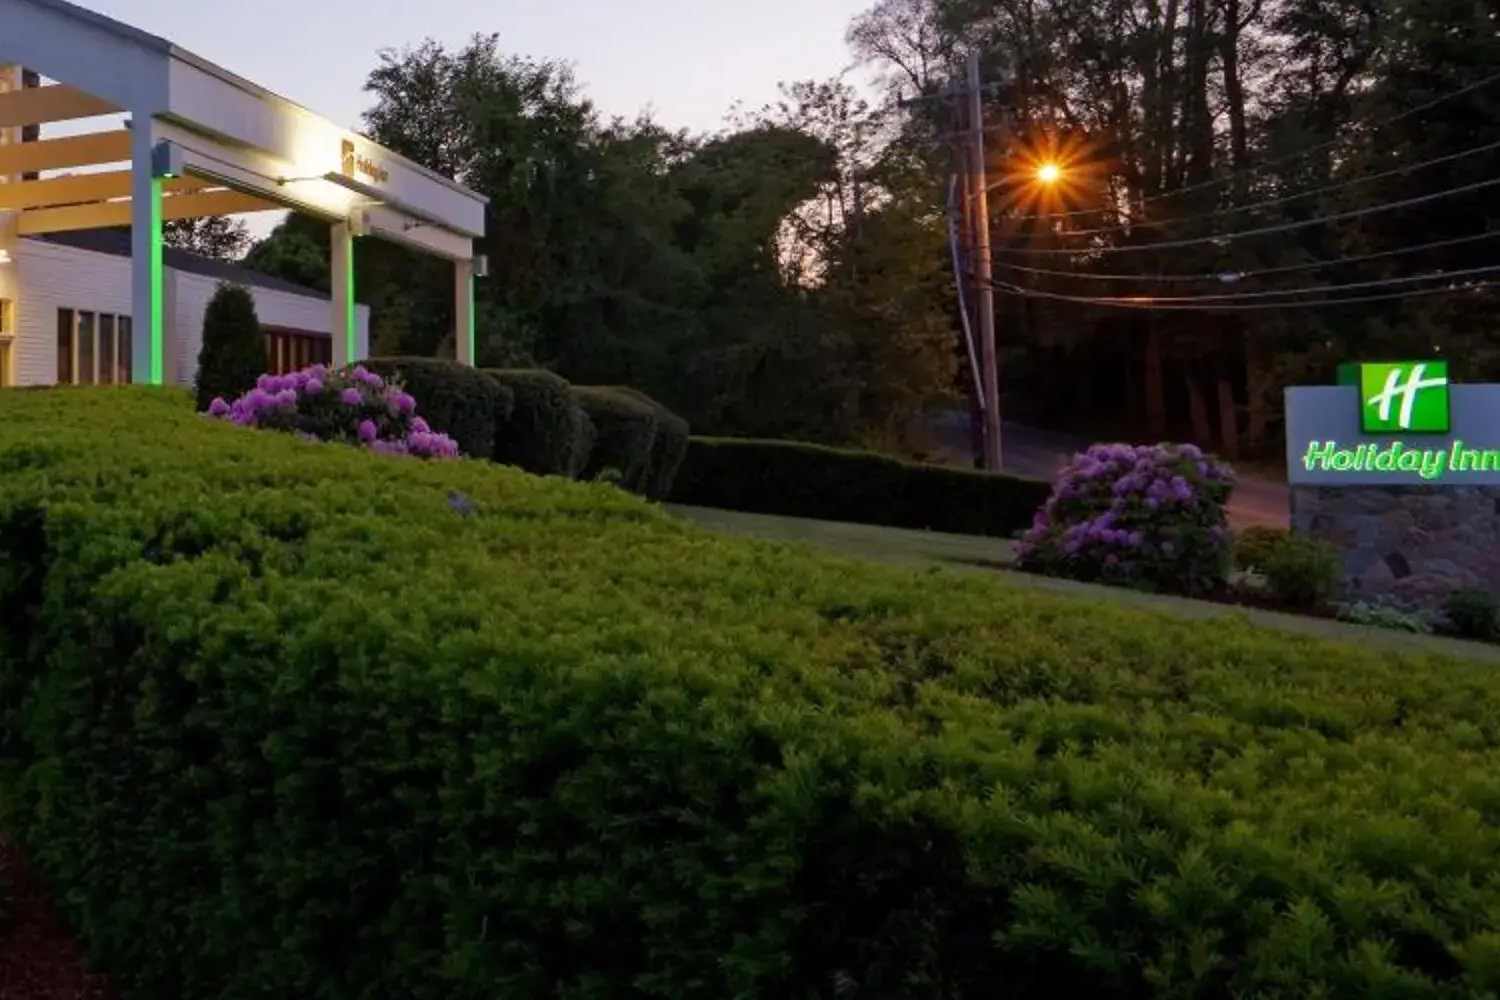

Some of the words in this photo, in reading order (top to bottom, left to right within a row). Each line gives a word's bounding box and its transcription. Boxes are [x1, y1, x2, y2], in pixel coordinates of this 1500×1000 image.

[1367, 363, 1447, 429] H
[1302, 440, 1446, 479] Holiday
[1449, 440, 1500, 471] Inn
